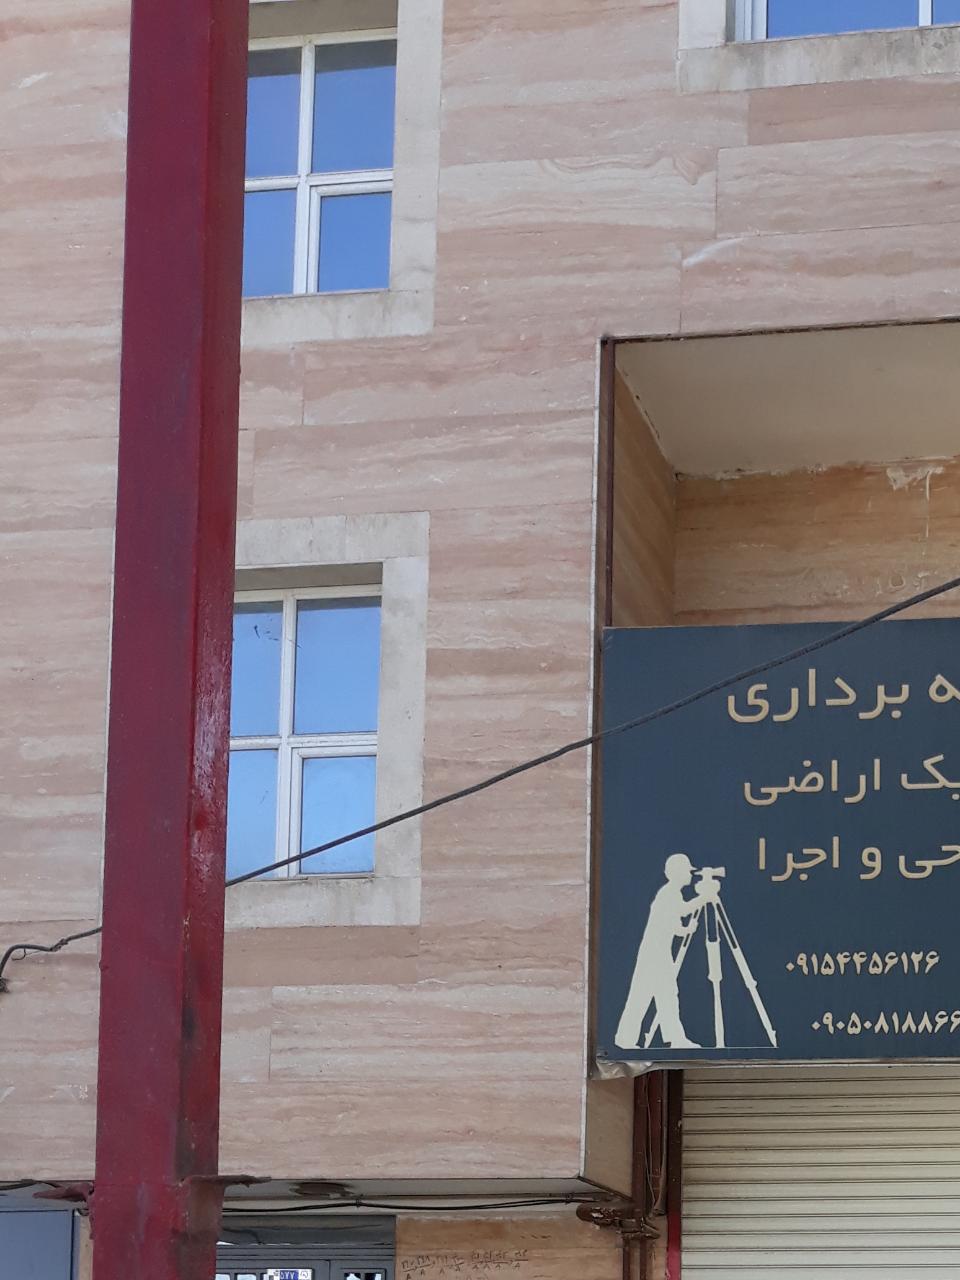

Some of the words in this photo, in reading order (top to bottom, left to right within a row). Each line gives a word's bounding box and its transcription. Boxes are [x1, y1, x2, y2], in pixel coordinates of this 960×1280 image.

[727, 668, 910, 723] برداری
[743, 758, 881, 806] اراضی
[758, 835, 840, 882] اجرا
[859, 847, 882, 880] و
[785, 950, 940, 977] ۰۹۱۵۴۴۵۶۱۲۶
